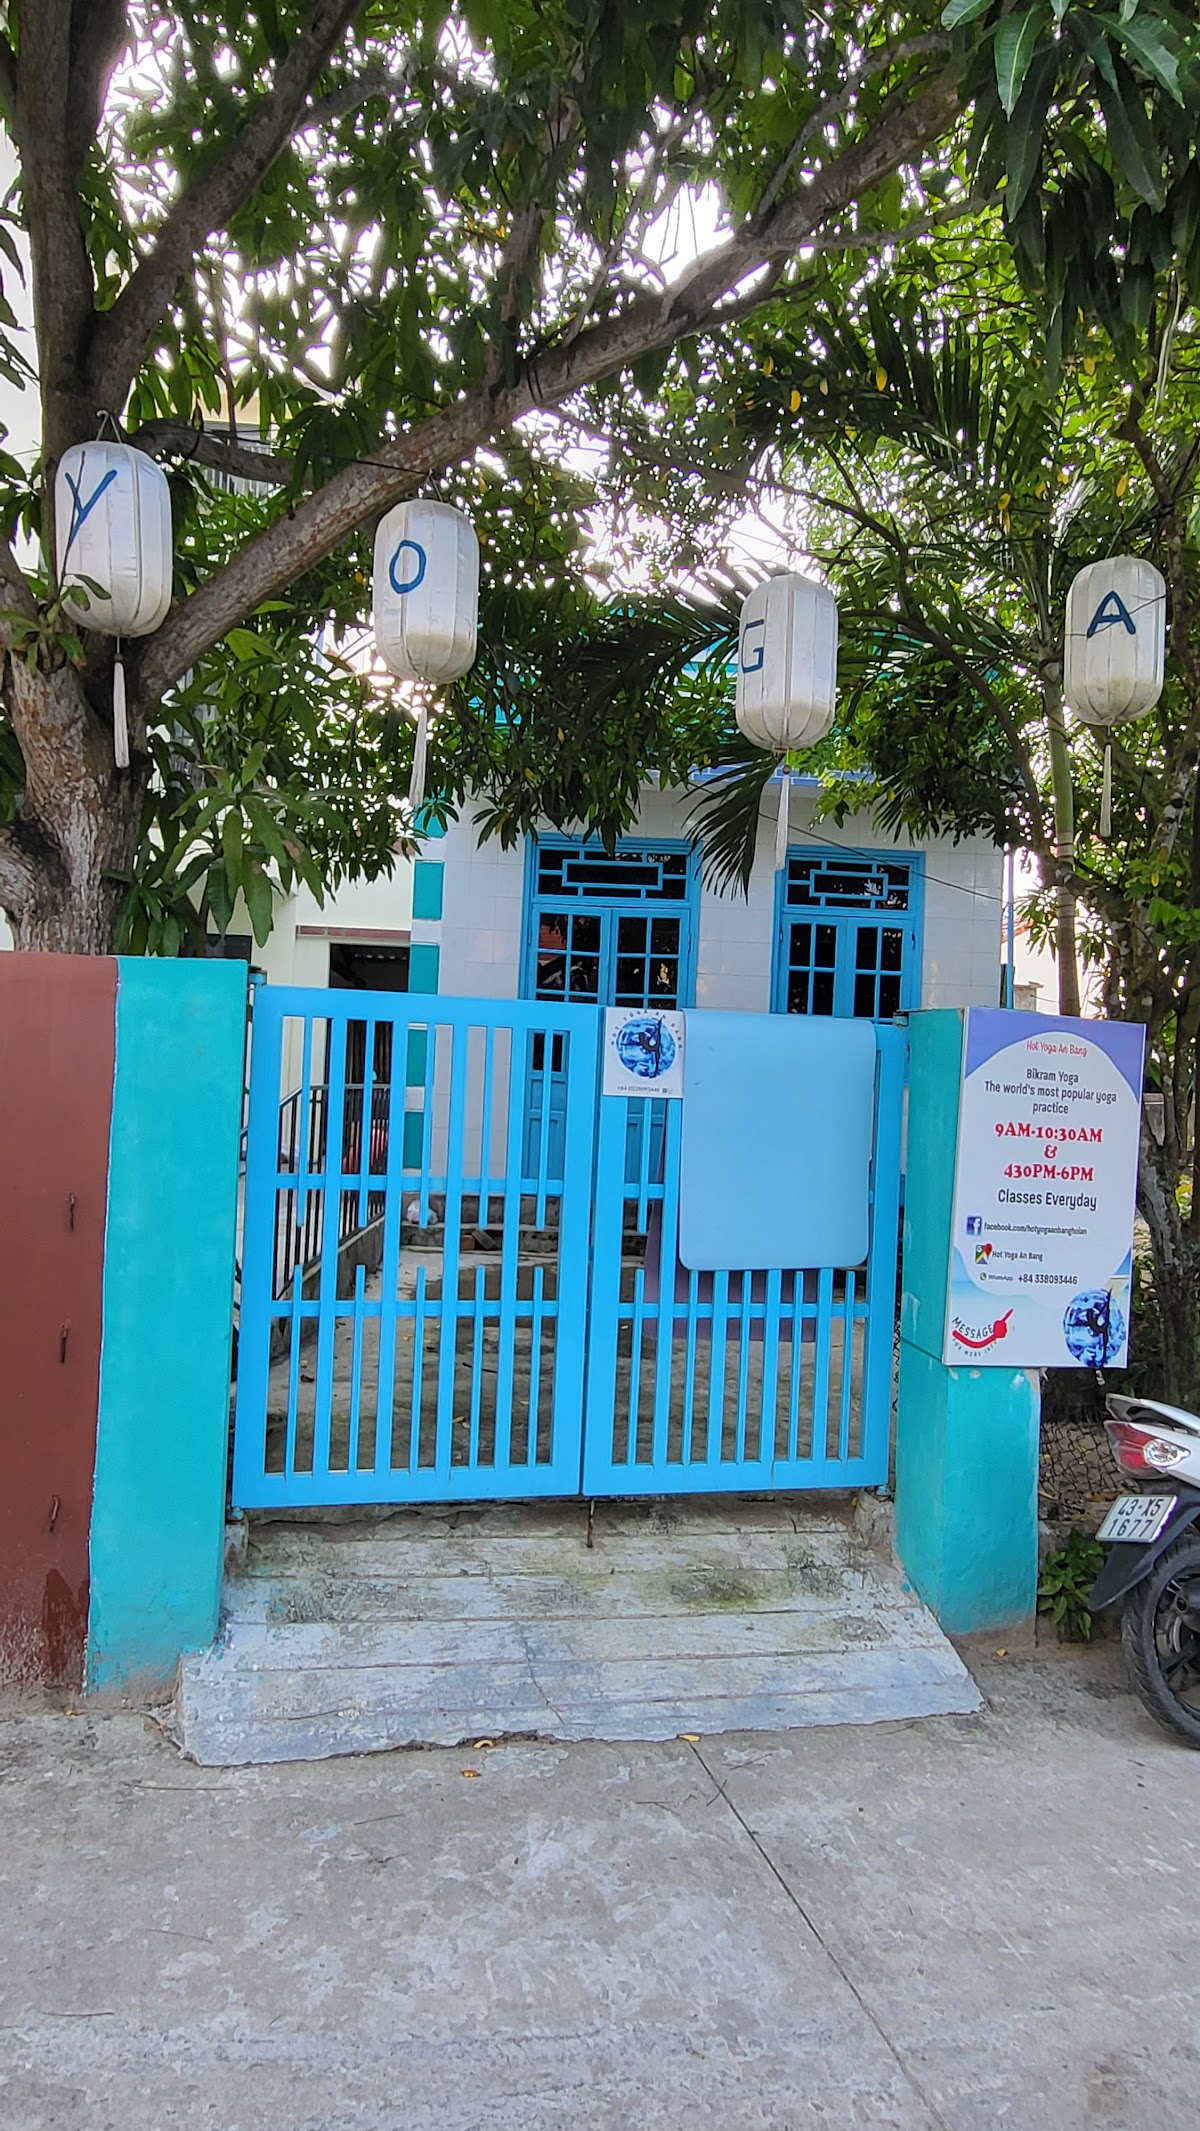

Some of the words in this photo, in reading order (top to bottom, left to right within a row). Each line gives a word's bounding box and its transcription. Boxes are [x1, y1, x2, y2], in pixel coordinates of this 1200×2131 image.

[64, 469, 118, 547] Y
[389, 540, 427, 594] O
[1086, 590, 1137, 639] A
[741, 619, 765, 674] G
[1026, 1040, 1040, 1051] Hot
[1040, 1041, 1057, 1053] Yoga
[1058, 1043, 1069, 1054] An
[1069, 1044, 1088, 1057] Bang
[1026, 1068, 1056, 1081] Bikram
[1058, 1071, 1079, 1086] Yoga
[985, 1081, 1001, 1093] The
[1003, 1083, 1035, 1096] world's
[1037, 1087, 1060, 1098] most
[1061, 1088, 1095, 1101] popular
[1096, 1091, 1117, 1105] yoga
[1032, 1101, 1069, 1115] practice
[994, 1122, 1103, 1143] 9AM-10:30AM
[1044, 1144, 1058, 1159] &
[1004, 1163, 1094, 1181] 430PM-6PM
[998, 1189, 1042, 1205] Classes
[1045, 1191, 1097, 1210] Everyday
[992, 1250, 1003, 1258] Hot
[1004, 1251, 1018, 1261] Yoga
[1019, 1251, 1028, 1259] An
[1028, 1252, 1043, 1262] Bang
[1018, 1273, 1033, 1284] +84
[1034, 1274, 1078, 1285] 338093446
[951, 1316, 994, 1339] MESSAGE
[1117, 1498, 1165, 1517] 43-X5
[1107, 1518, 1154, 1538] 1677
